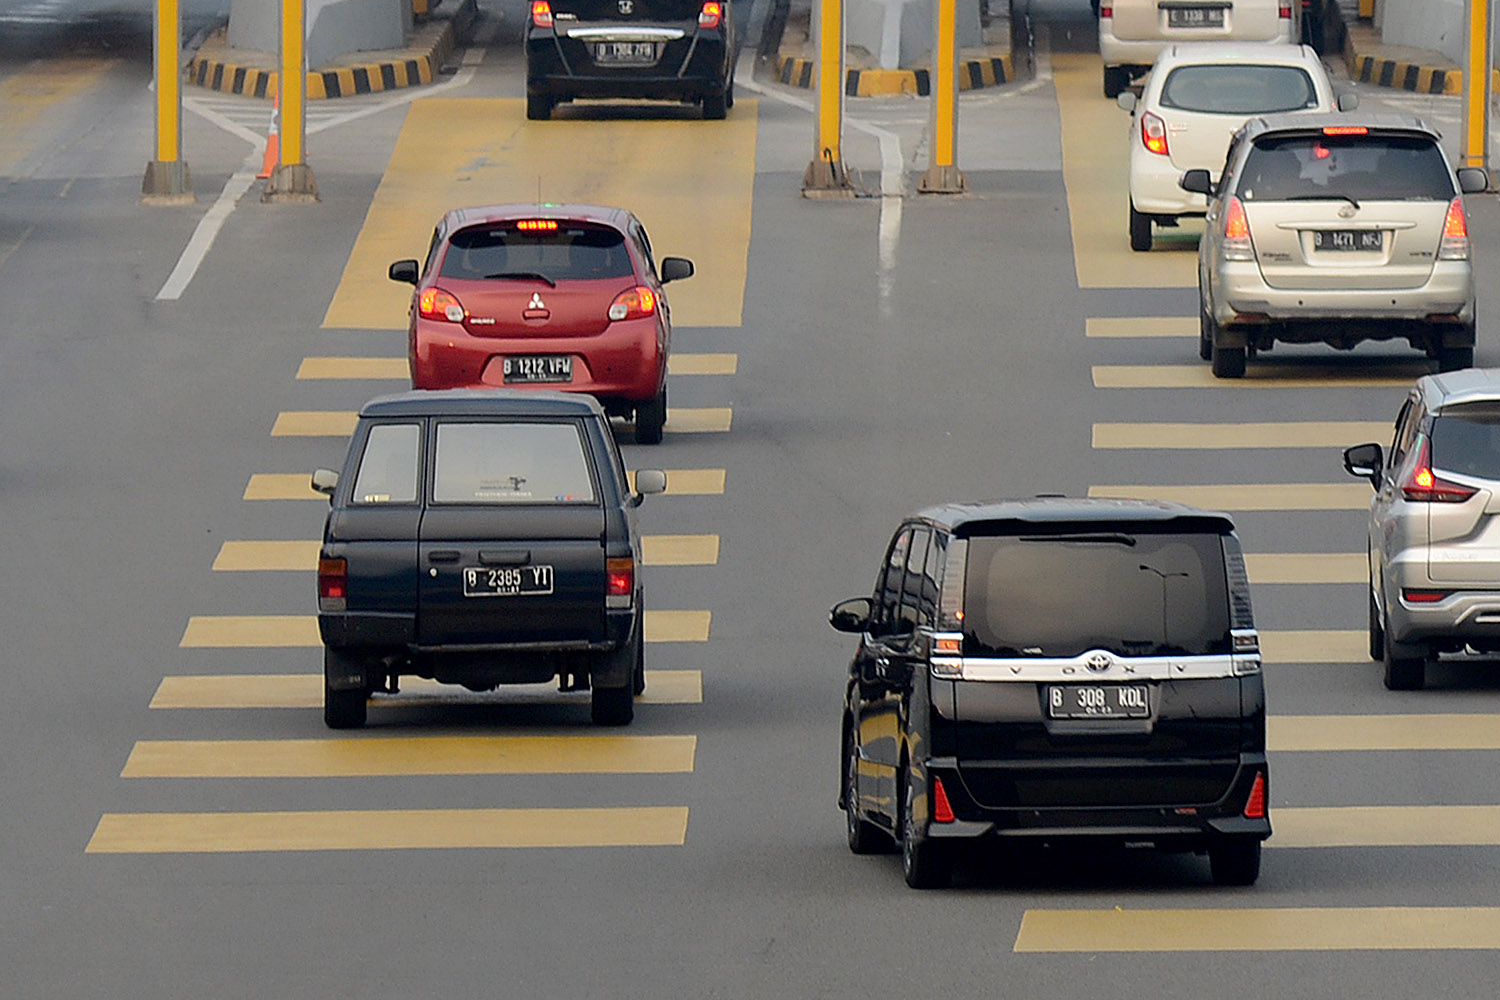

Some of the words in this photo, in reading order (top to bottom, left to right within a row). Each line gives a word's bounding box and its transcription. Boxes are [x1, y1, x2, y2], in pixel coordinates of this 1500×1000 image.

[1315, 232, 1323, 246] B
[503, 359, 512, 375] B
[519, 358, 545, 374] 1212
[468, 570, 477, 587] B
[488, 569, 521, 587] 2385
[1052, 688, 1063, 707] B
[1077, 688, 1105, 707] 308
